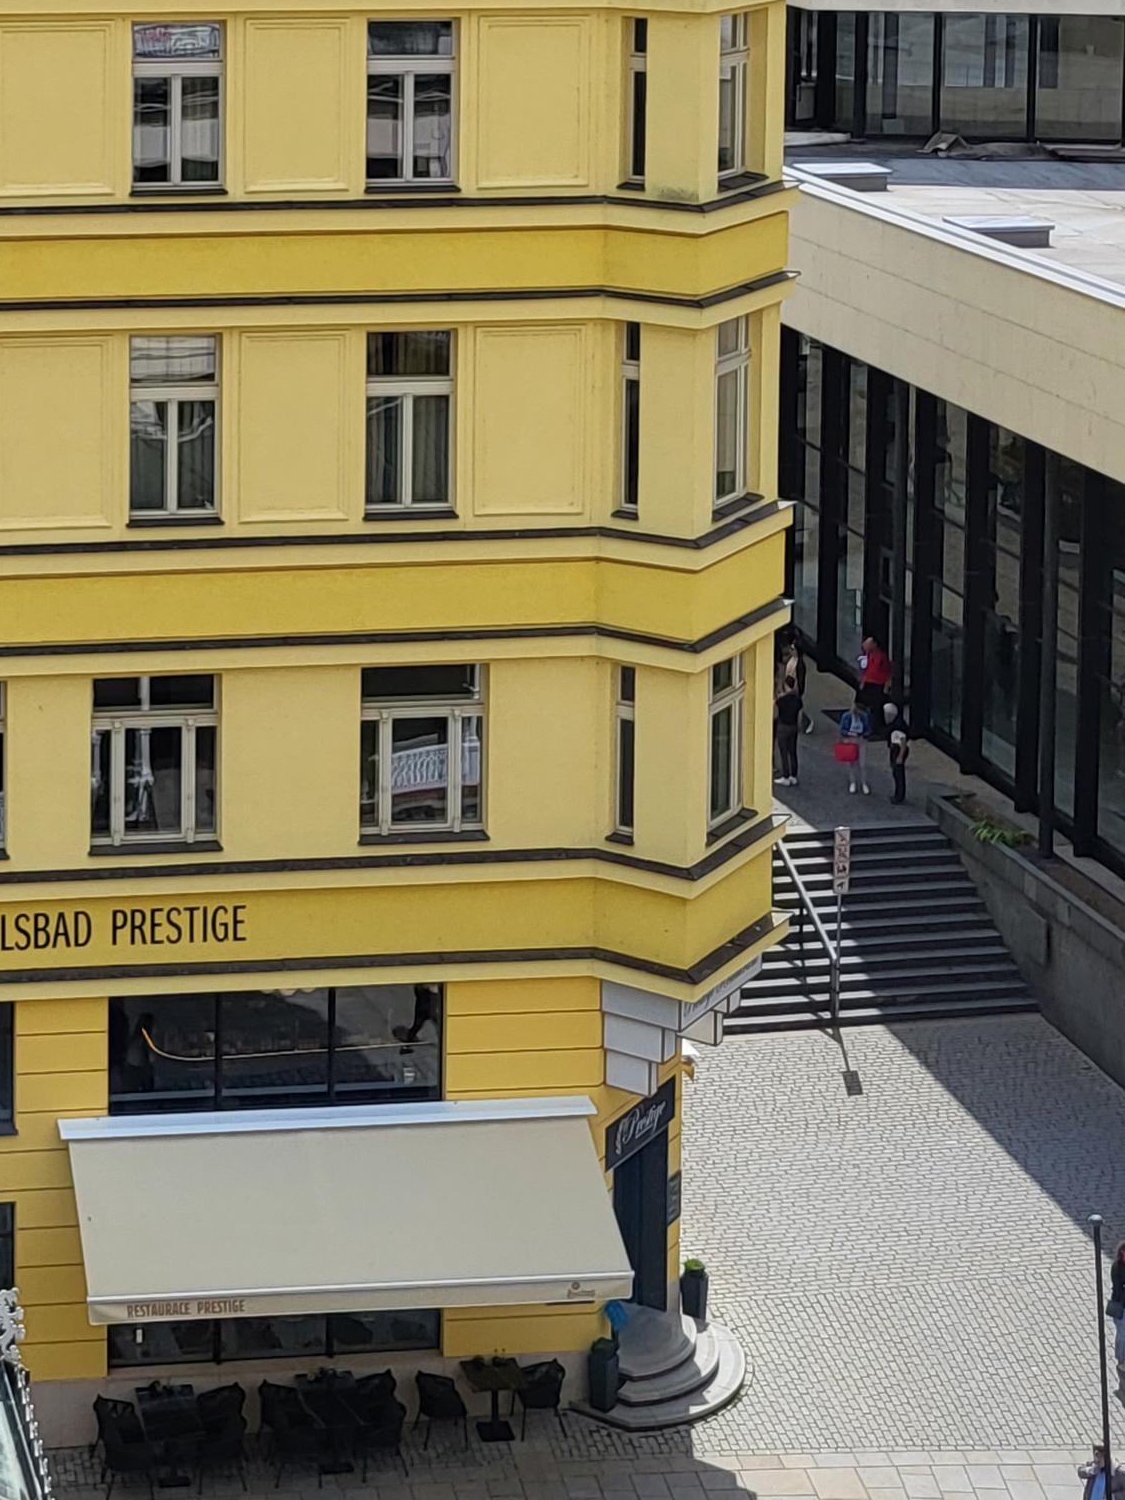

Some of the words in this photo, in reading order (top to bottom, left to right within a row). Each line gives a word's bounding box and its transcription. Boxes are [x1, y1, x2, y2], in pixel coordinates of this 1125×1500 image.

[112, 905, 247, 946] PRESTIGE
[126, 1302, 191, 1318] RESTAURACE
[197, 1300, 246, 1315] PRESTIGE
